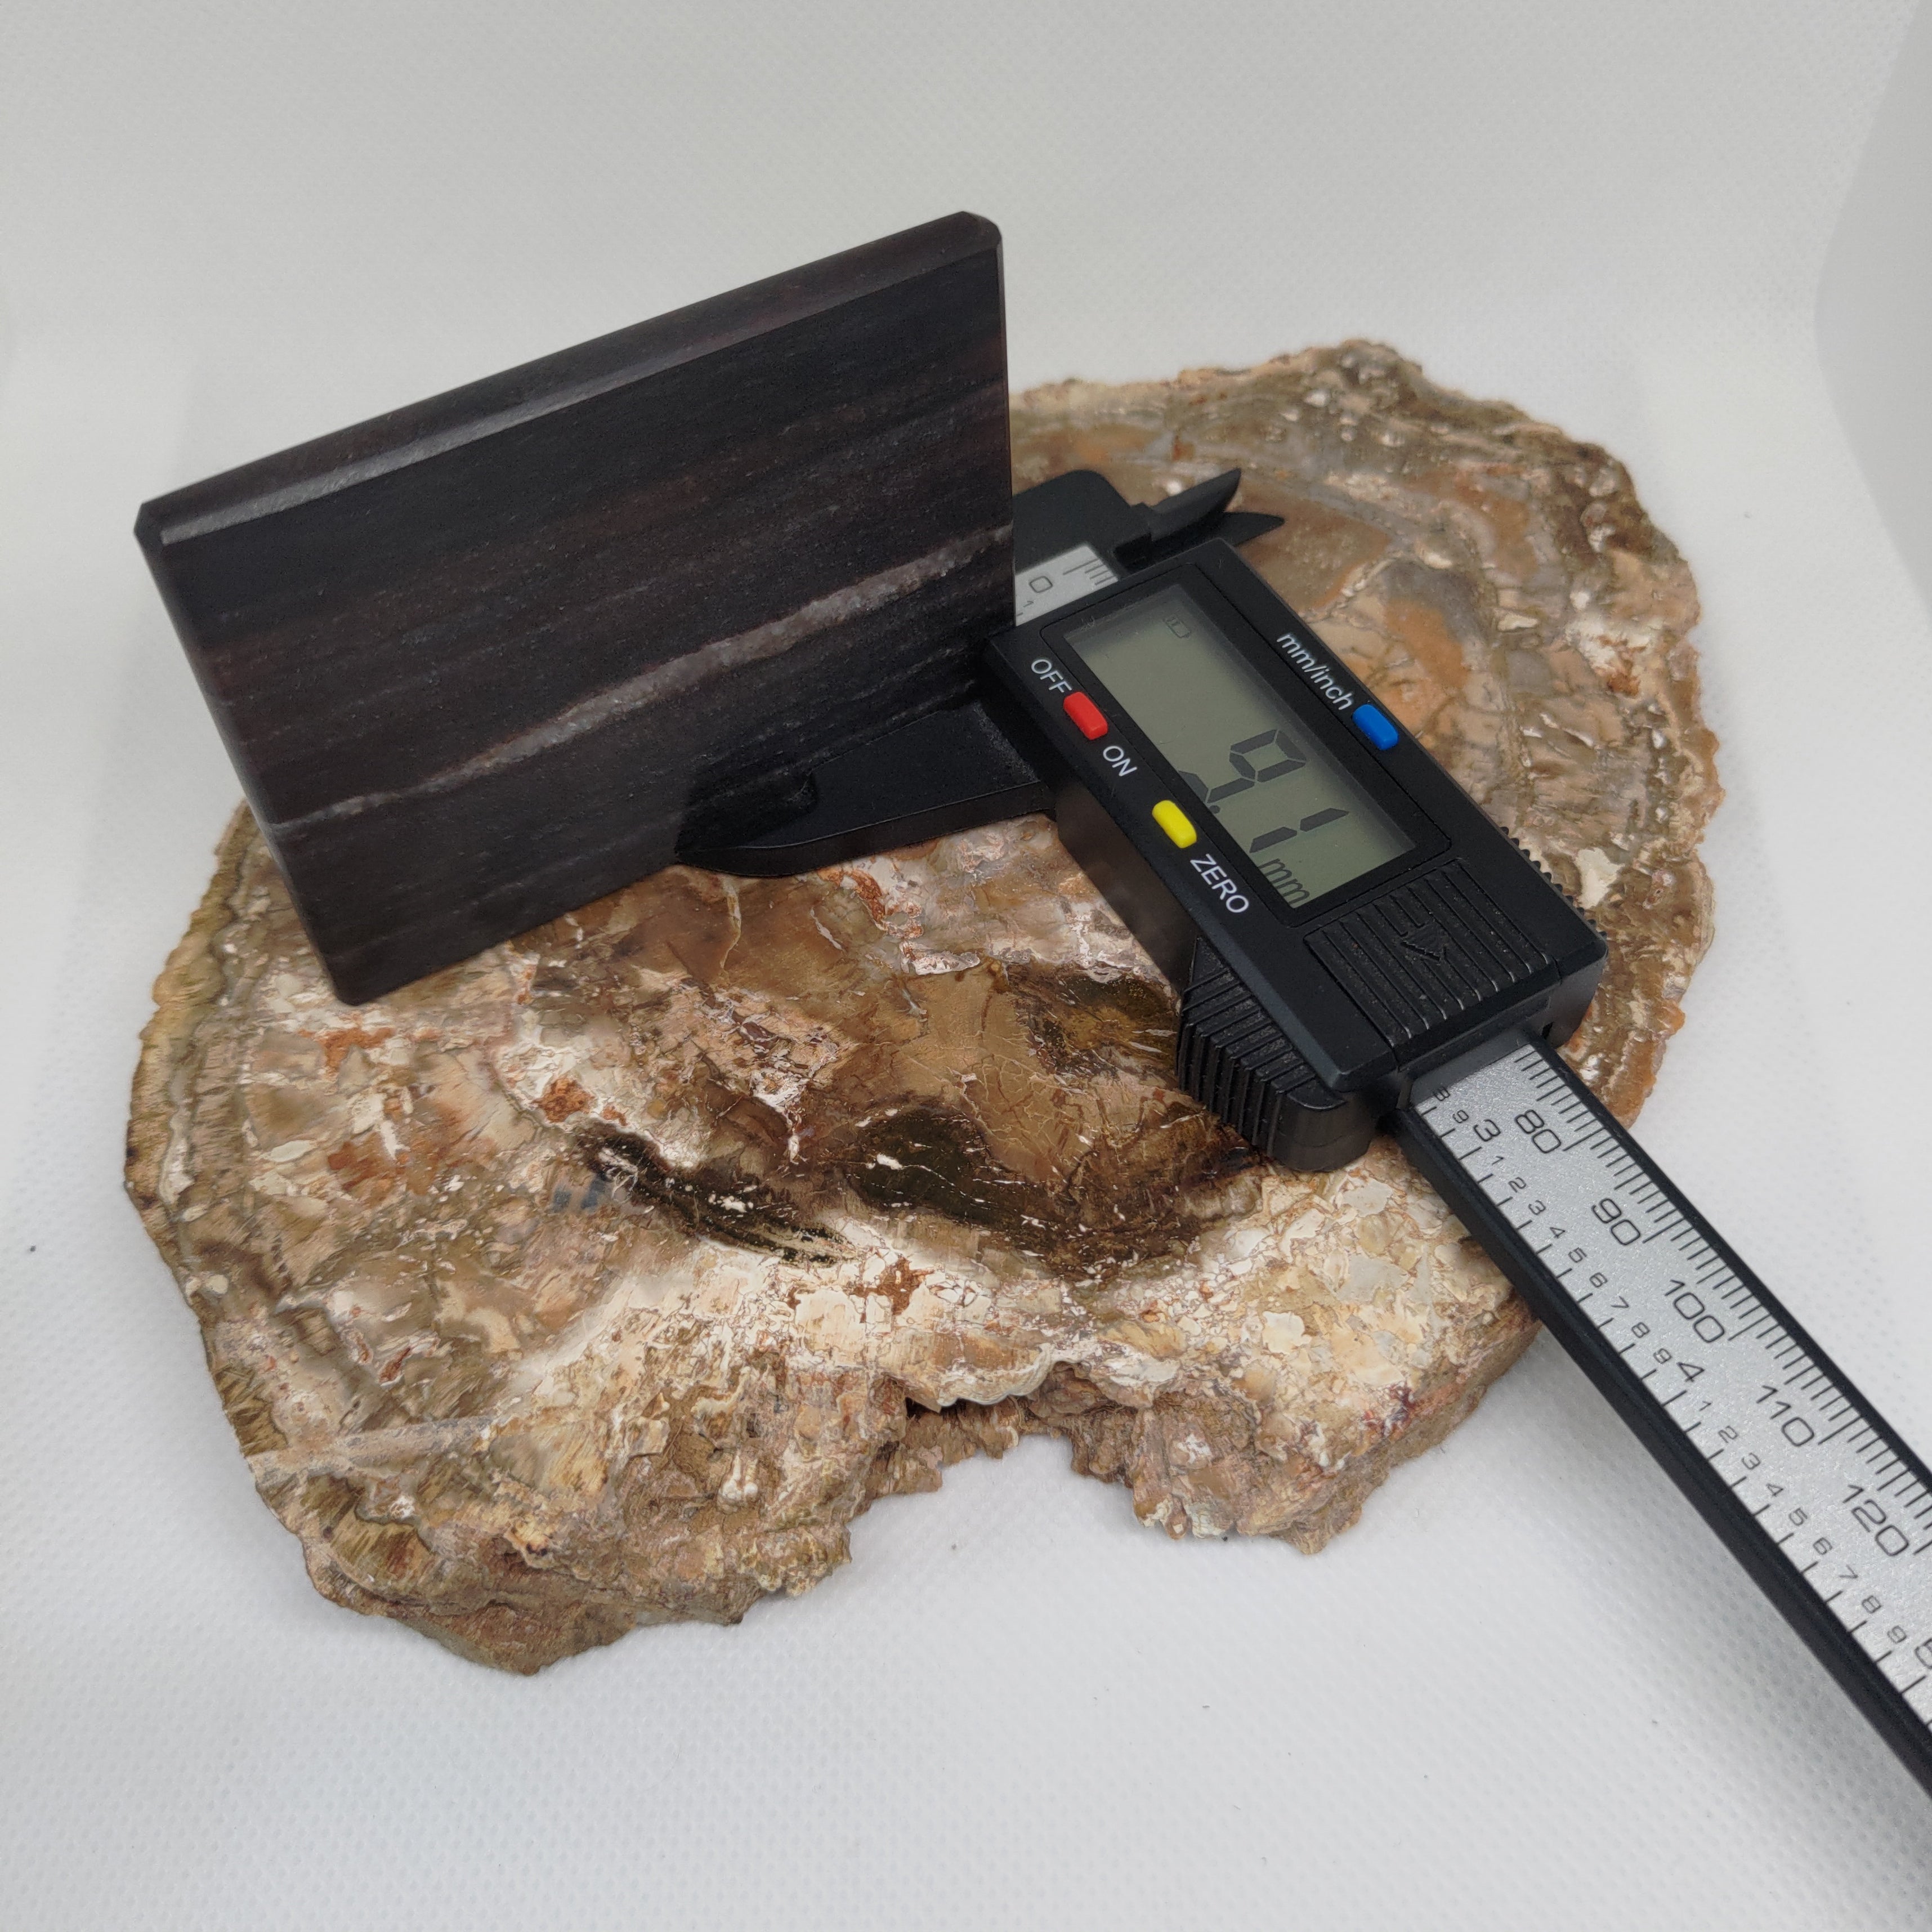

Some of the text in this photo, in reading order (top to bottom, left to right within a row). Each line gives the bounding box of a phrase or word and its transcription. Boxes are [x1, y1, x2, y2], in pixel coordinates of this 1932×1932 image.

[1029, 575, 1053, 593] 0
[1031, 659, 1072, 694] OFF
[1276, 632, 1354, 710] mm/inch
[1102, 744, 1138, 777] ON
[1189, 853, 1250, 914] ZERO
[1257, 858, 1311, 905] mm
[1516, 1110, 1909, 1556] 80 90 100 110 120
[1452, 1110, 1469, 1124] 9
[1473, 1119, 1501, 1142] 3
[1492, 1156, 1504, 1165] 1
[1509, 1177, 1526, 1193] 2
[1528, 1200, 1546, 1215] 3
[1550, 1227, 1565, 1238] 4
[1568, 1247, 1587, 1263] 5
[1590, 1272, 1607, 1288] 6
[1612, 1296, 1629, 1311] 7
[1632, 1322, 1650, 1338] 8
[1653, 1348, 1672, 1364] 9
[1678, 1361, 1705, 1383] 4
[1700, 1401, 1712, 1411] 1
[1718, 1425, 1738, 1443] 2
[1741, 1453, 1761, 1470] 3
[1766, 1482, 1785, 1496] 4
[1788, 1508, 1808, 1526] 5
[1813, 1537, 1832, 1555] 6
[1840, 1564, 1858, 1579] 7
[1862, 1595, 1882, 1613] 8
[1887, 1626, 1907, 1643] 9
